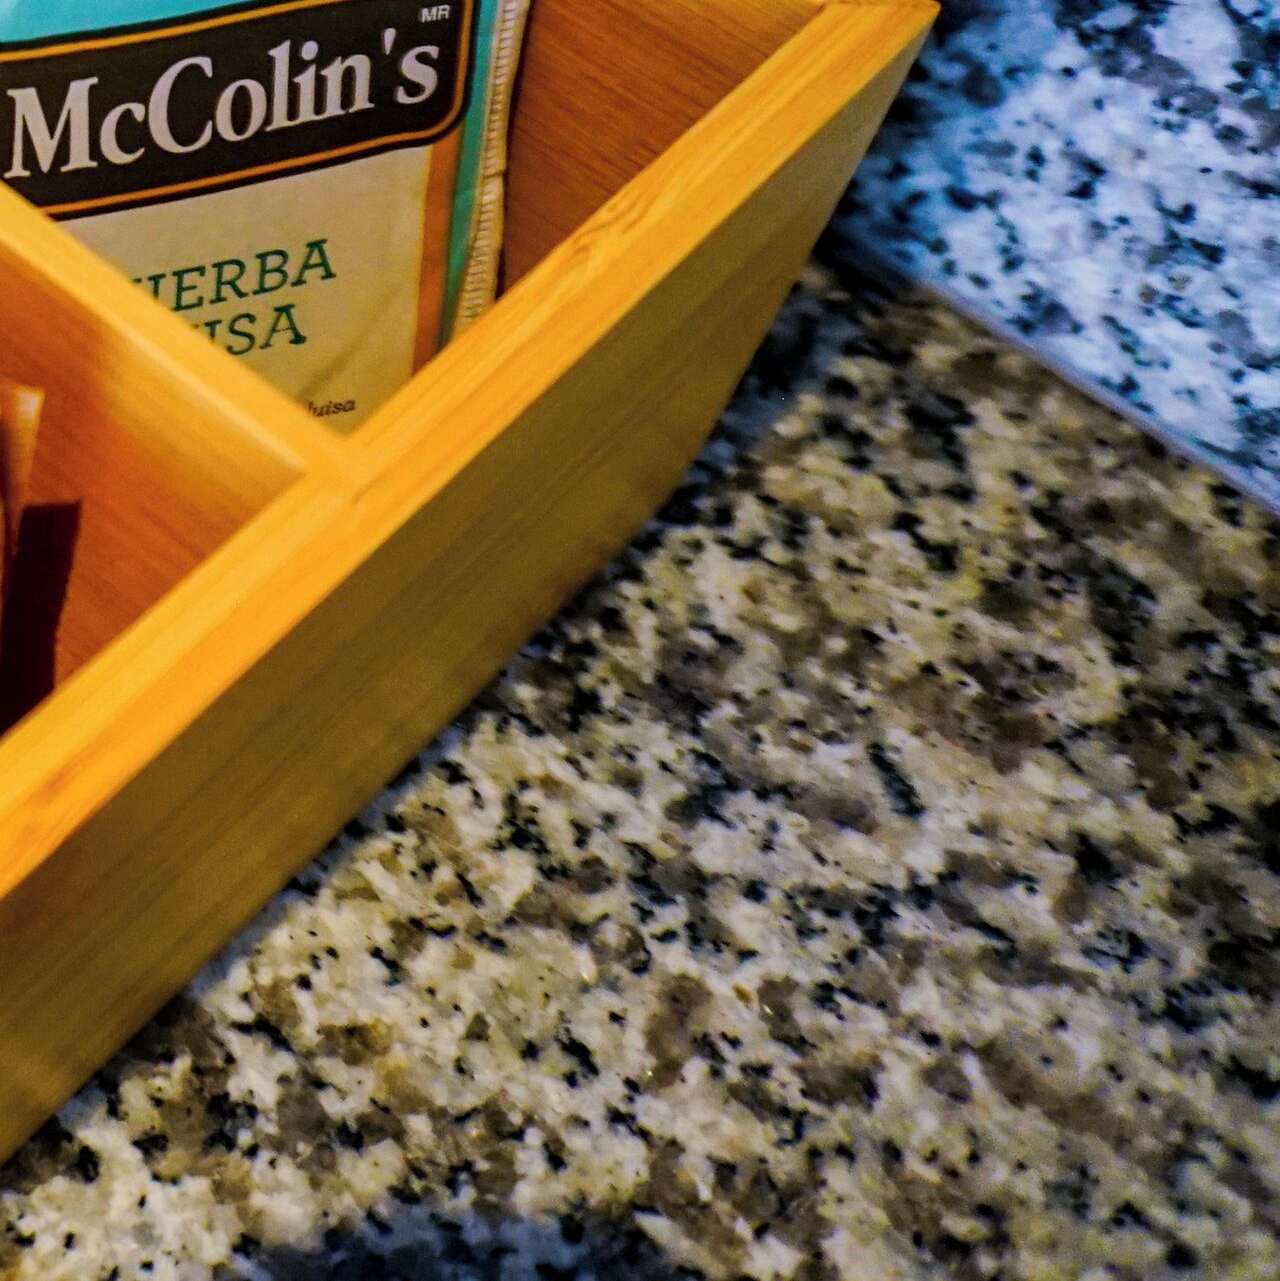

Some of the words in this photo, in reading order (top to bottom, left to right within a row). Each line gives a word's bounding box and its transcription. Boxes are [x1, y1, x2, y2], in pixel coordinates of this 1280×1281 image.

[421, 4, 450, 23] MR
[3, 28, 440, 180] McColin's
[132, 238, 337, 311] IERBA
